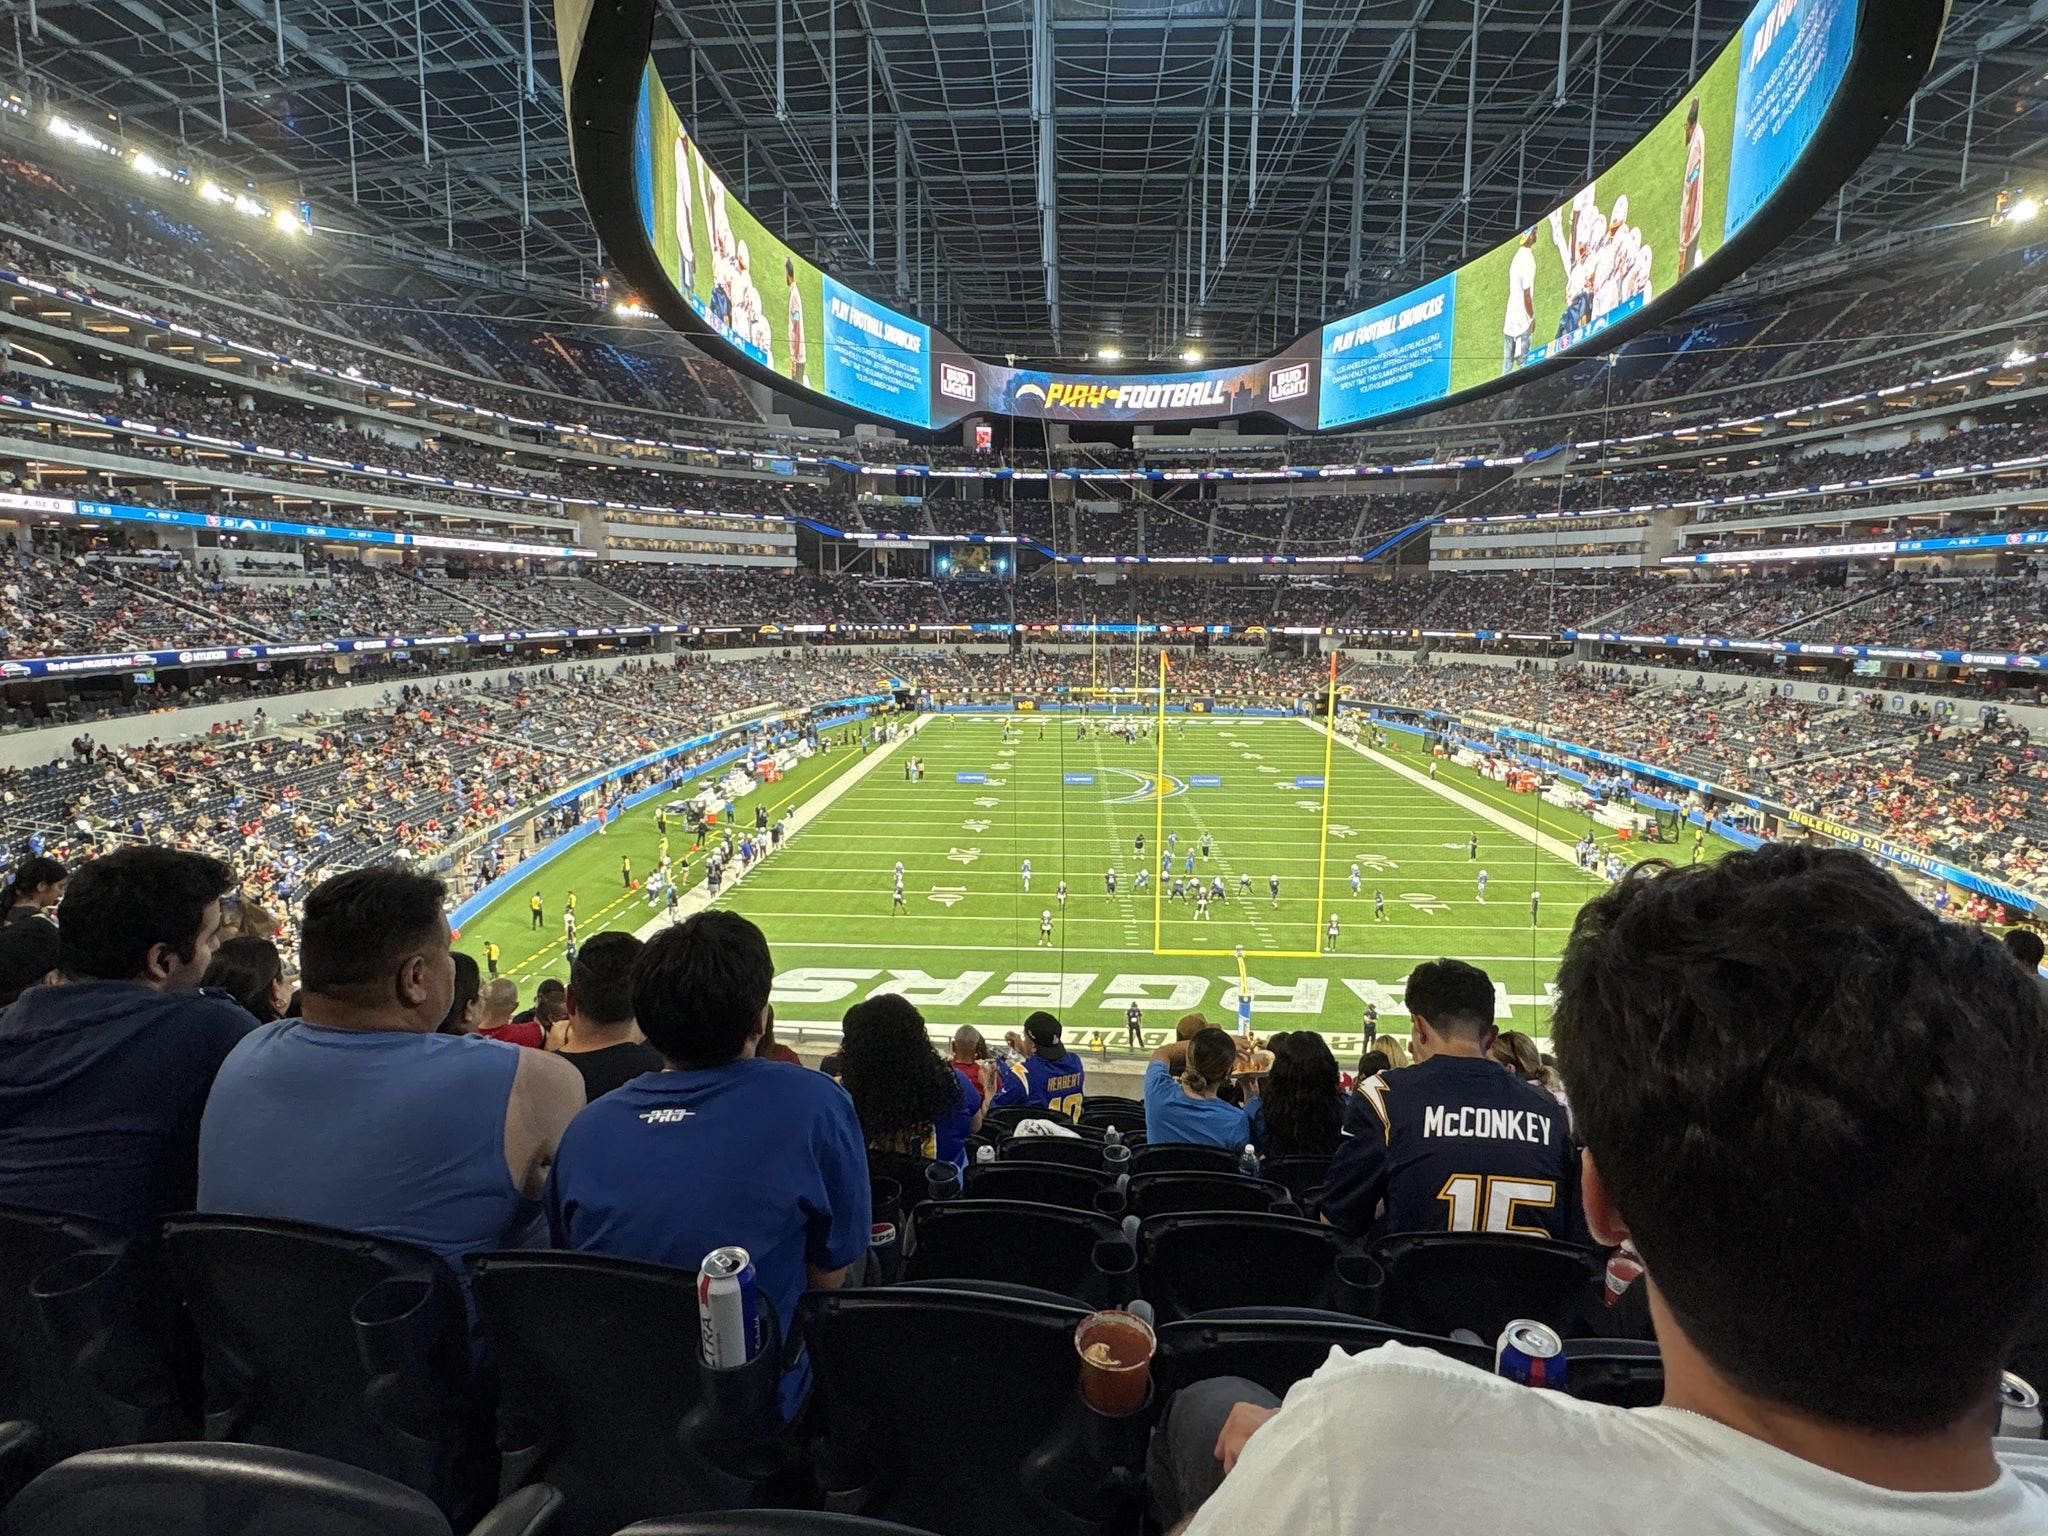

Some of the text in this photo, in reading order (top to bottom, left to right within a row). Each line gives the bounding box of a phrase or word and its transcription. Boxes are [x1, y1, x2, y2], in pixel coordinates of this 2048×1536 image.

[1332, 294, 1445, 354] PLAY FOOTBALL SHOWCASE
[946, 368, 969, 385] BUD
[1277, 369, 1302, 386] BUD
[943, 379, 973, 397] LIGHT
[1044, 380, 1224, 409] PLAY FOOTBALL
[1271, 379, 1306, 399] LIGHT
[193, 650, 226, 661] HYUNDAI
[1973, 655, 2006, 665] HYUNDAI
[1788, 811, 1943, 874] INGLEWOOD CALIFORNIA
[768, 967, 1566, 1018] HARGERS
[1047, 1073, 1081, 1092] HERBERT
[1424, 1105, 1551, 1146] McCONKEY
[872, 1230, 894, 1243] EPSI
[702, 1317, 716, 1368] LTRA
